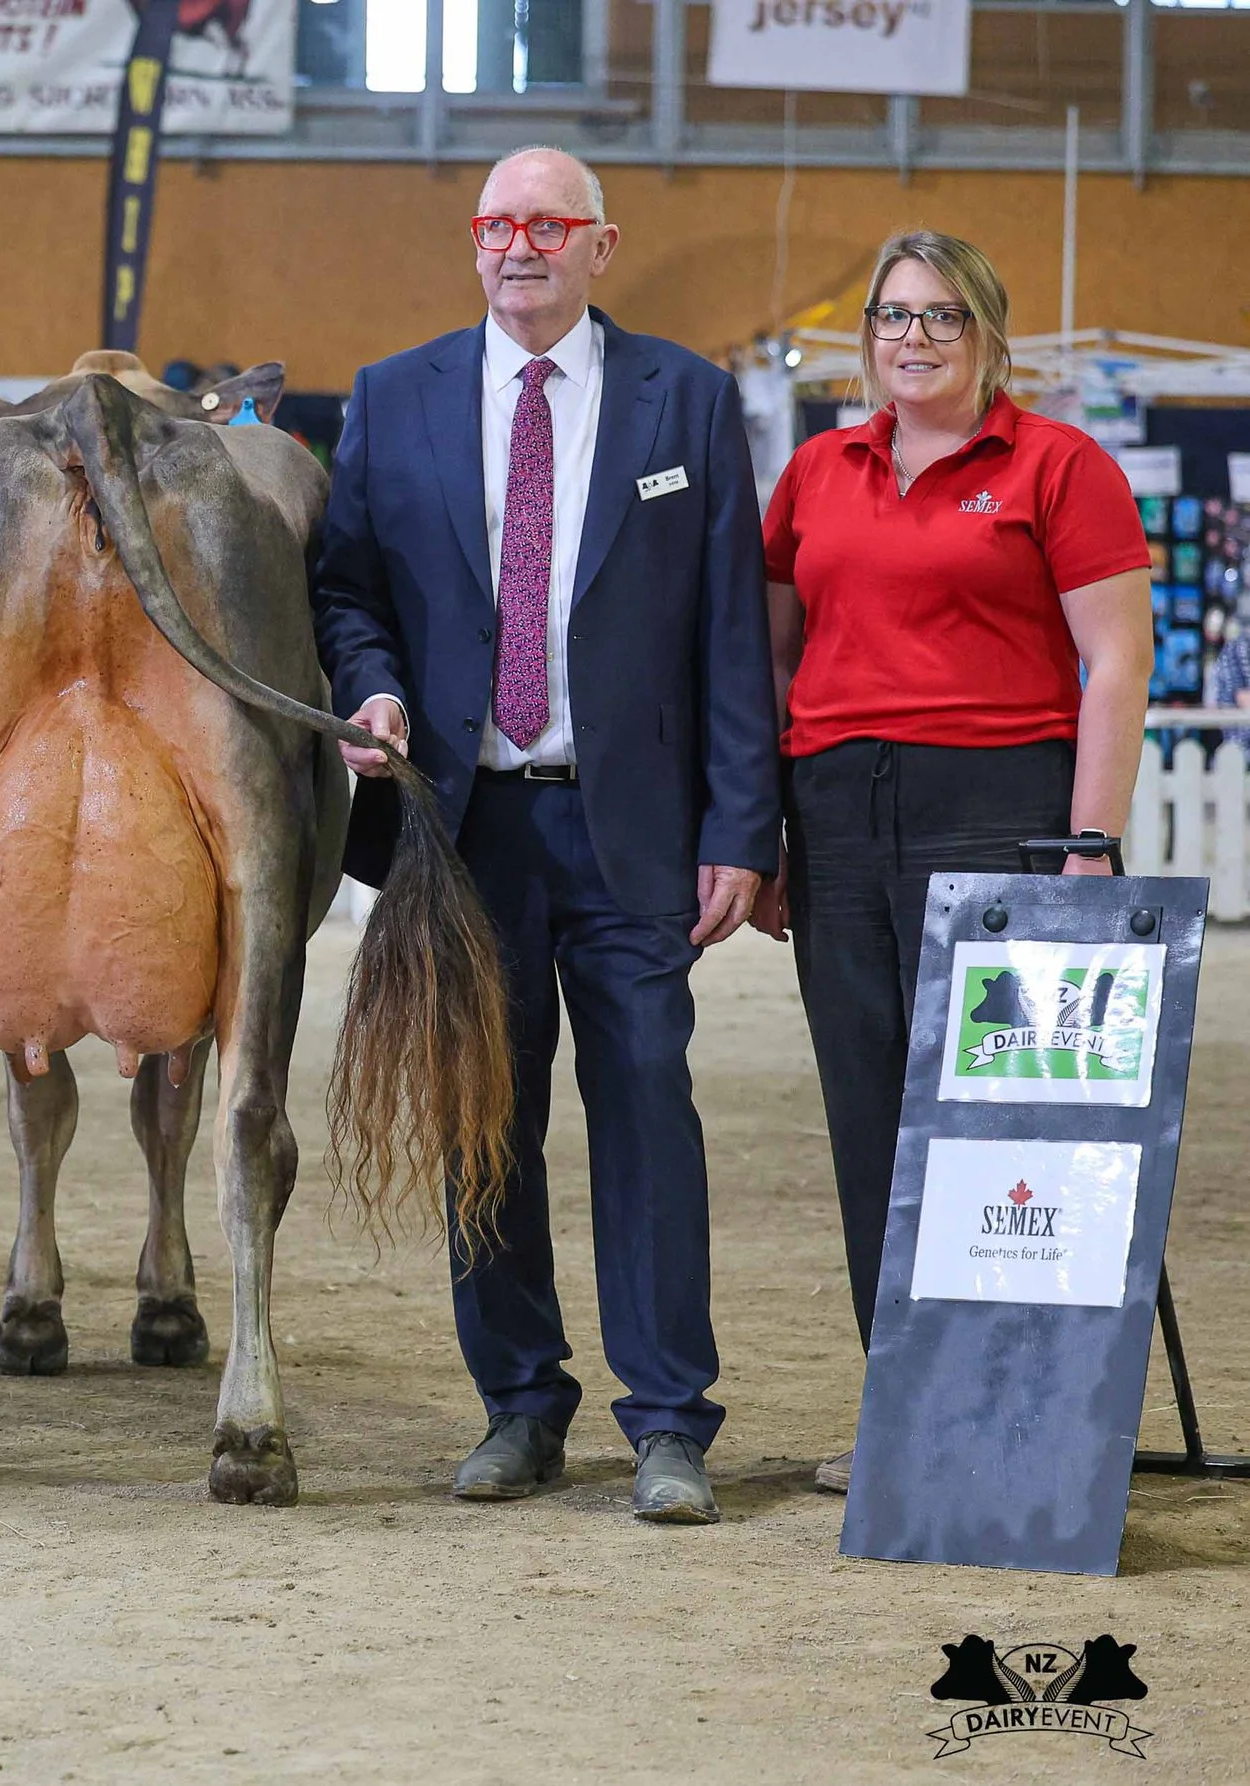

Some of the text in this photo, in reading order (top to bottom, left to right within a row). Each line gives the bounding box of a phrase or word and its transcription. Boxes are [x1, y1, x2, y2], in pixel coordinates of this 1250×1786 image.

[958, 500, 1003, 514] SEMEX
[994, 1030, 1105, 1051] DAIREVENT
[981, 1205, 1058, 1237] SEMEX
[969, 1245, 1063, 1261] Genetics for Life
